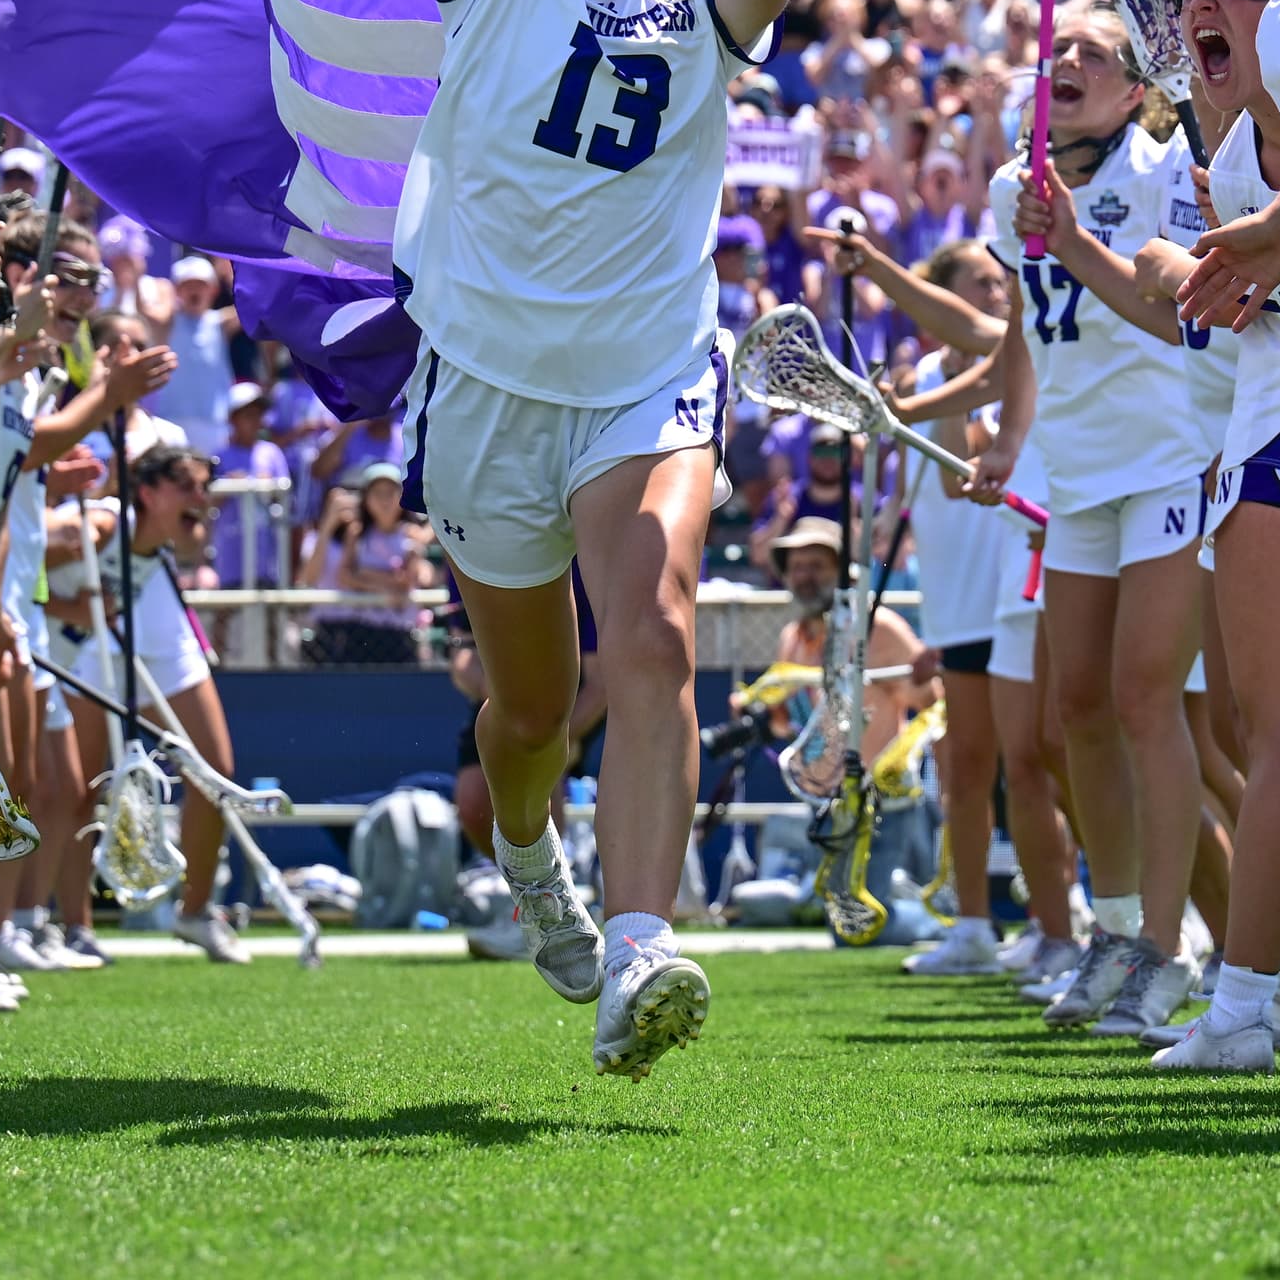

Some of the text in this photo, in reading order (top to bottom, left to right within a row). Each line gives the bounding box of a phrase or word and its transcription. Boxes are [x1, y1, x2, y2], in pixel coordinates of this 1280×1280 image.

[532, 19, 671, 173] 13
[1022, 263, 1084, 345] 17
[675, 397, 699, 432] N
[1163, 506, 1186, 535] N
